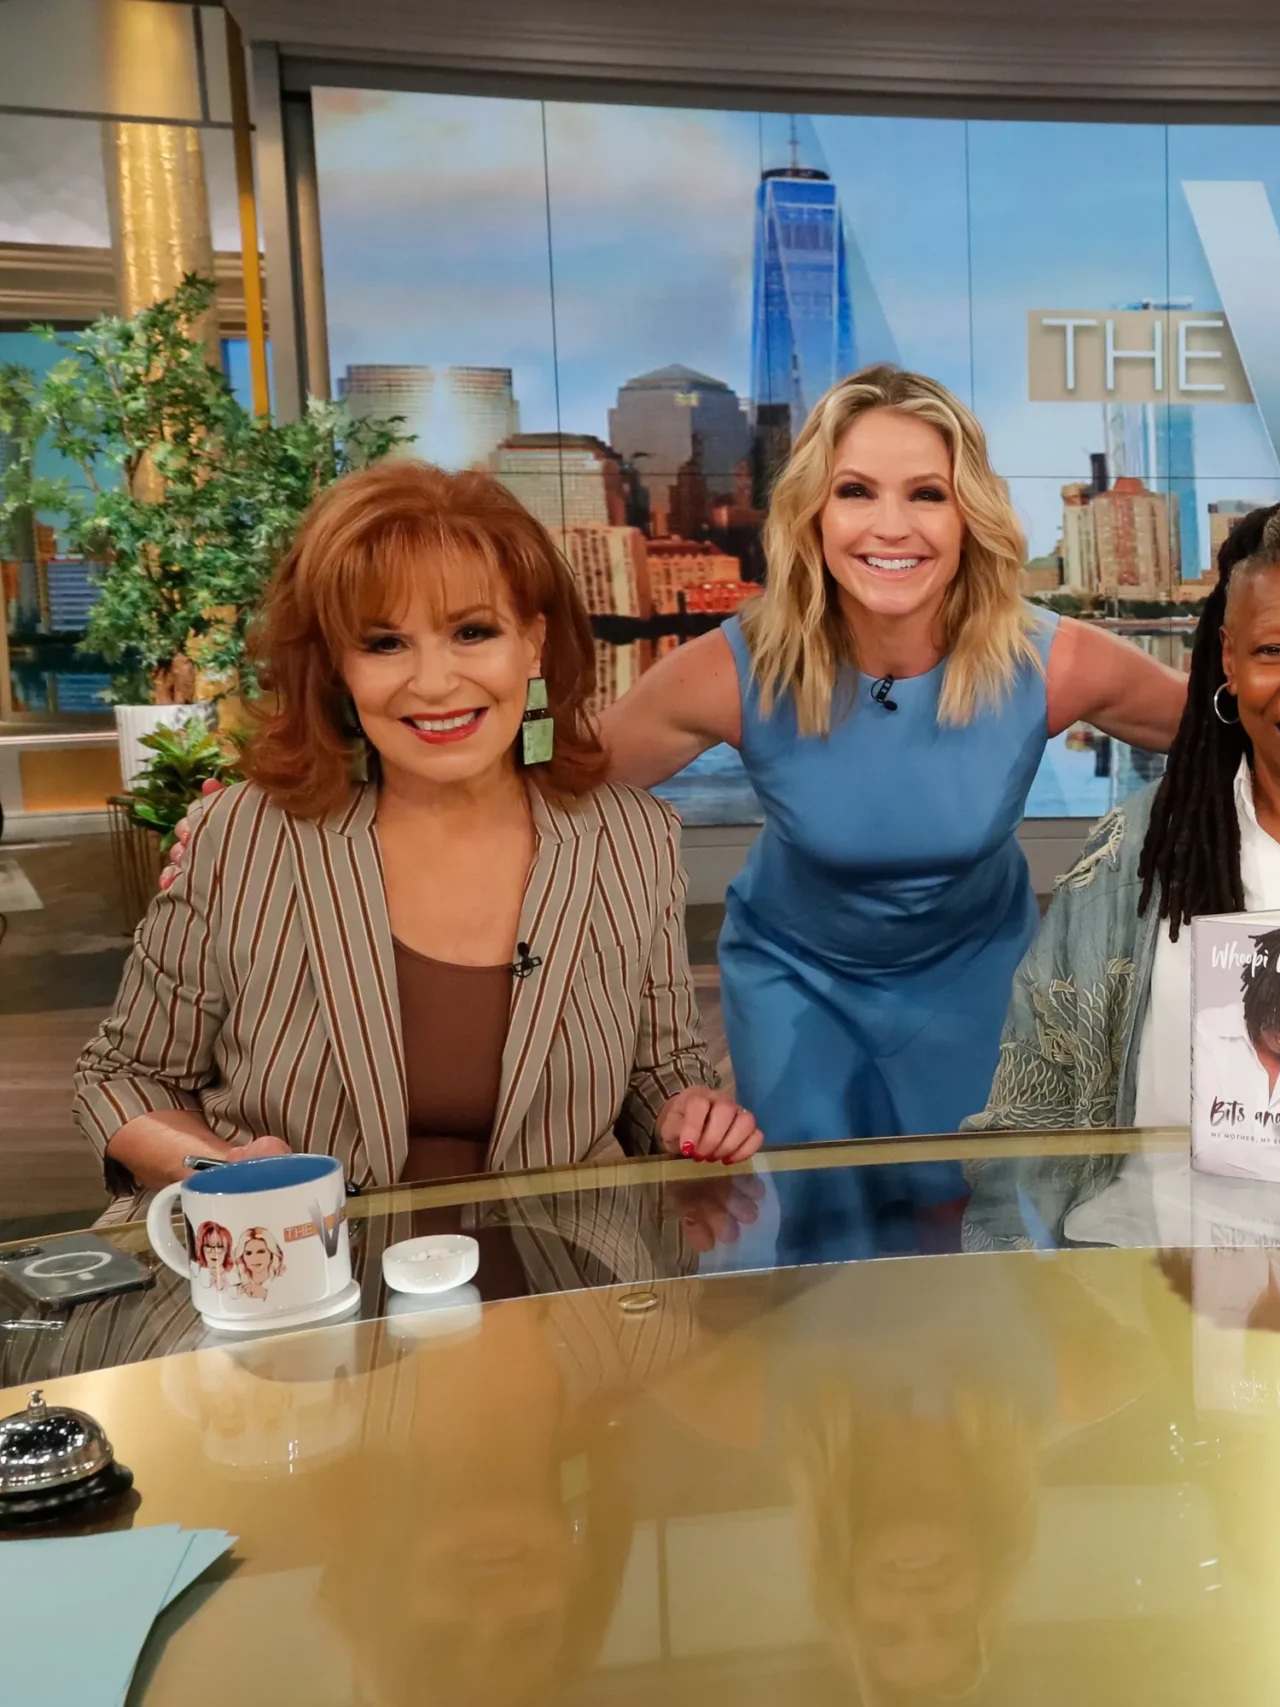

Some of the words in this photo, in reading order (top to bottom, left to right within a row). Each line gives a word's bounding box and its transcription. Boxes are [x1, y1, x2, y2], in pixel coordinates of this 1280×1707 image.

[1041, 317, 1225, 392] THE
[1211, 940, 1269, 978] Whoopi
[1209, 1096, 1246, 1127] Bits
[1224, 1133, 1258, 1144] MOTHER,
[285, 1223, 313, 1241] THE
